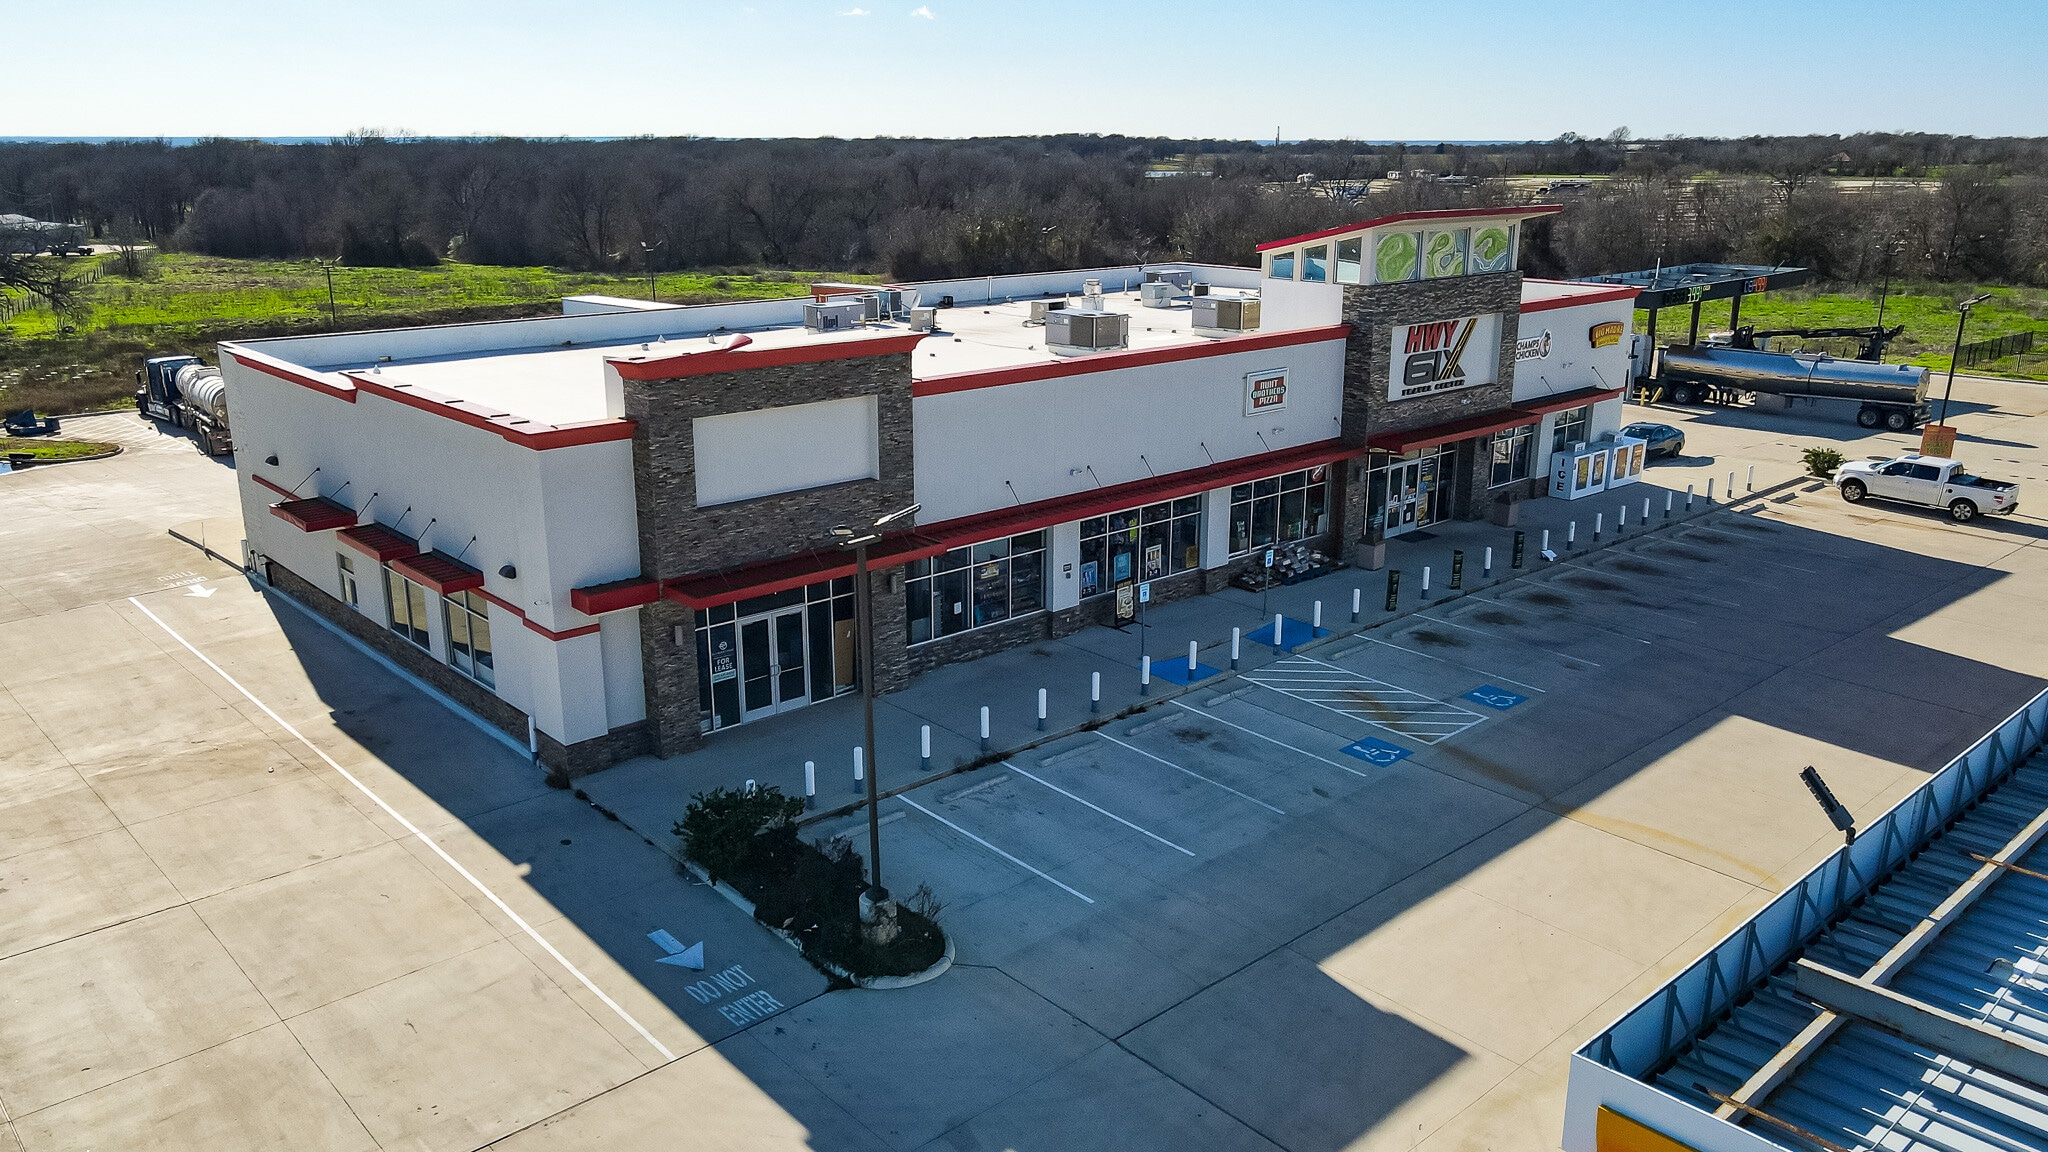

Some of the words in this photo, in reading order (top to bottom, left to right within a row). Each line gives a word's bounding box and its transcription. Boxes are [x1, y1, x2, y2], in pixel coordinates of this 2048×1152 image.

[1404, 320, 1459, 354] HWY
[1516, 339, 1540, 351] CHAMPS
[1515, 348, 1540, 360] CHICKEN
[1259, 395, 1278, 405] PIZZA
[1556, 458, 1566, 491] ICE
[714, 662, 733, 672] LEASE
[716, 657, 730, 665] FOR
[684, 980, 722, 1005] DO
[709, 964, 756, 993] NOT
[717, 989, 785, 1027] ENTER
